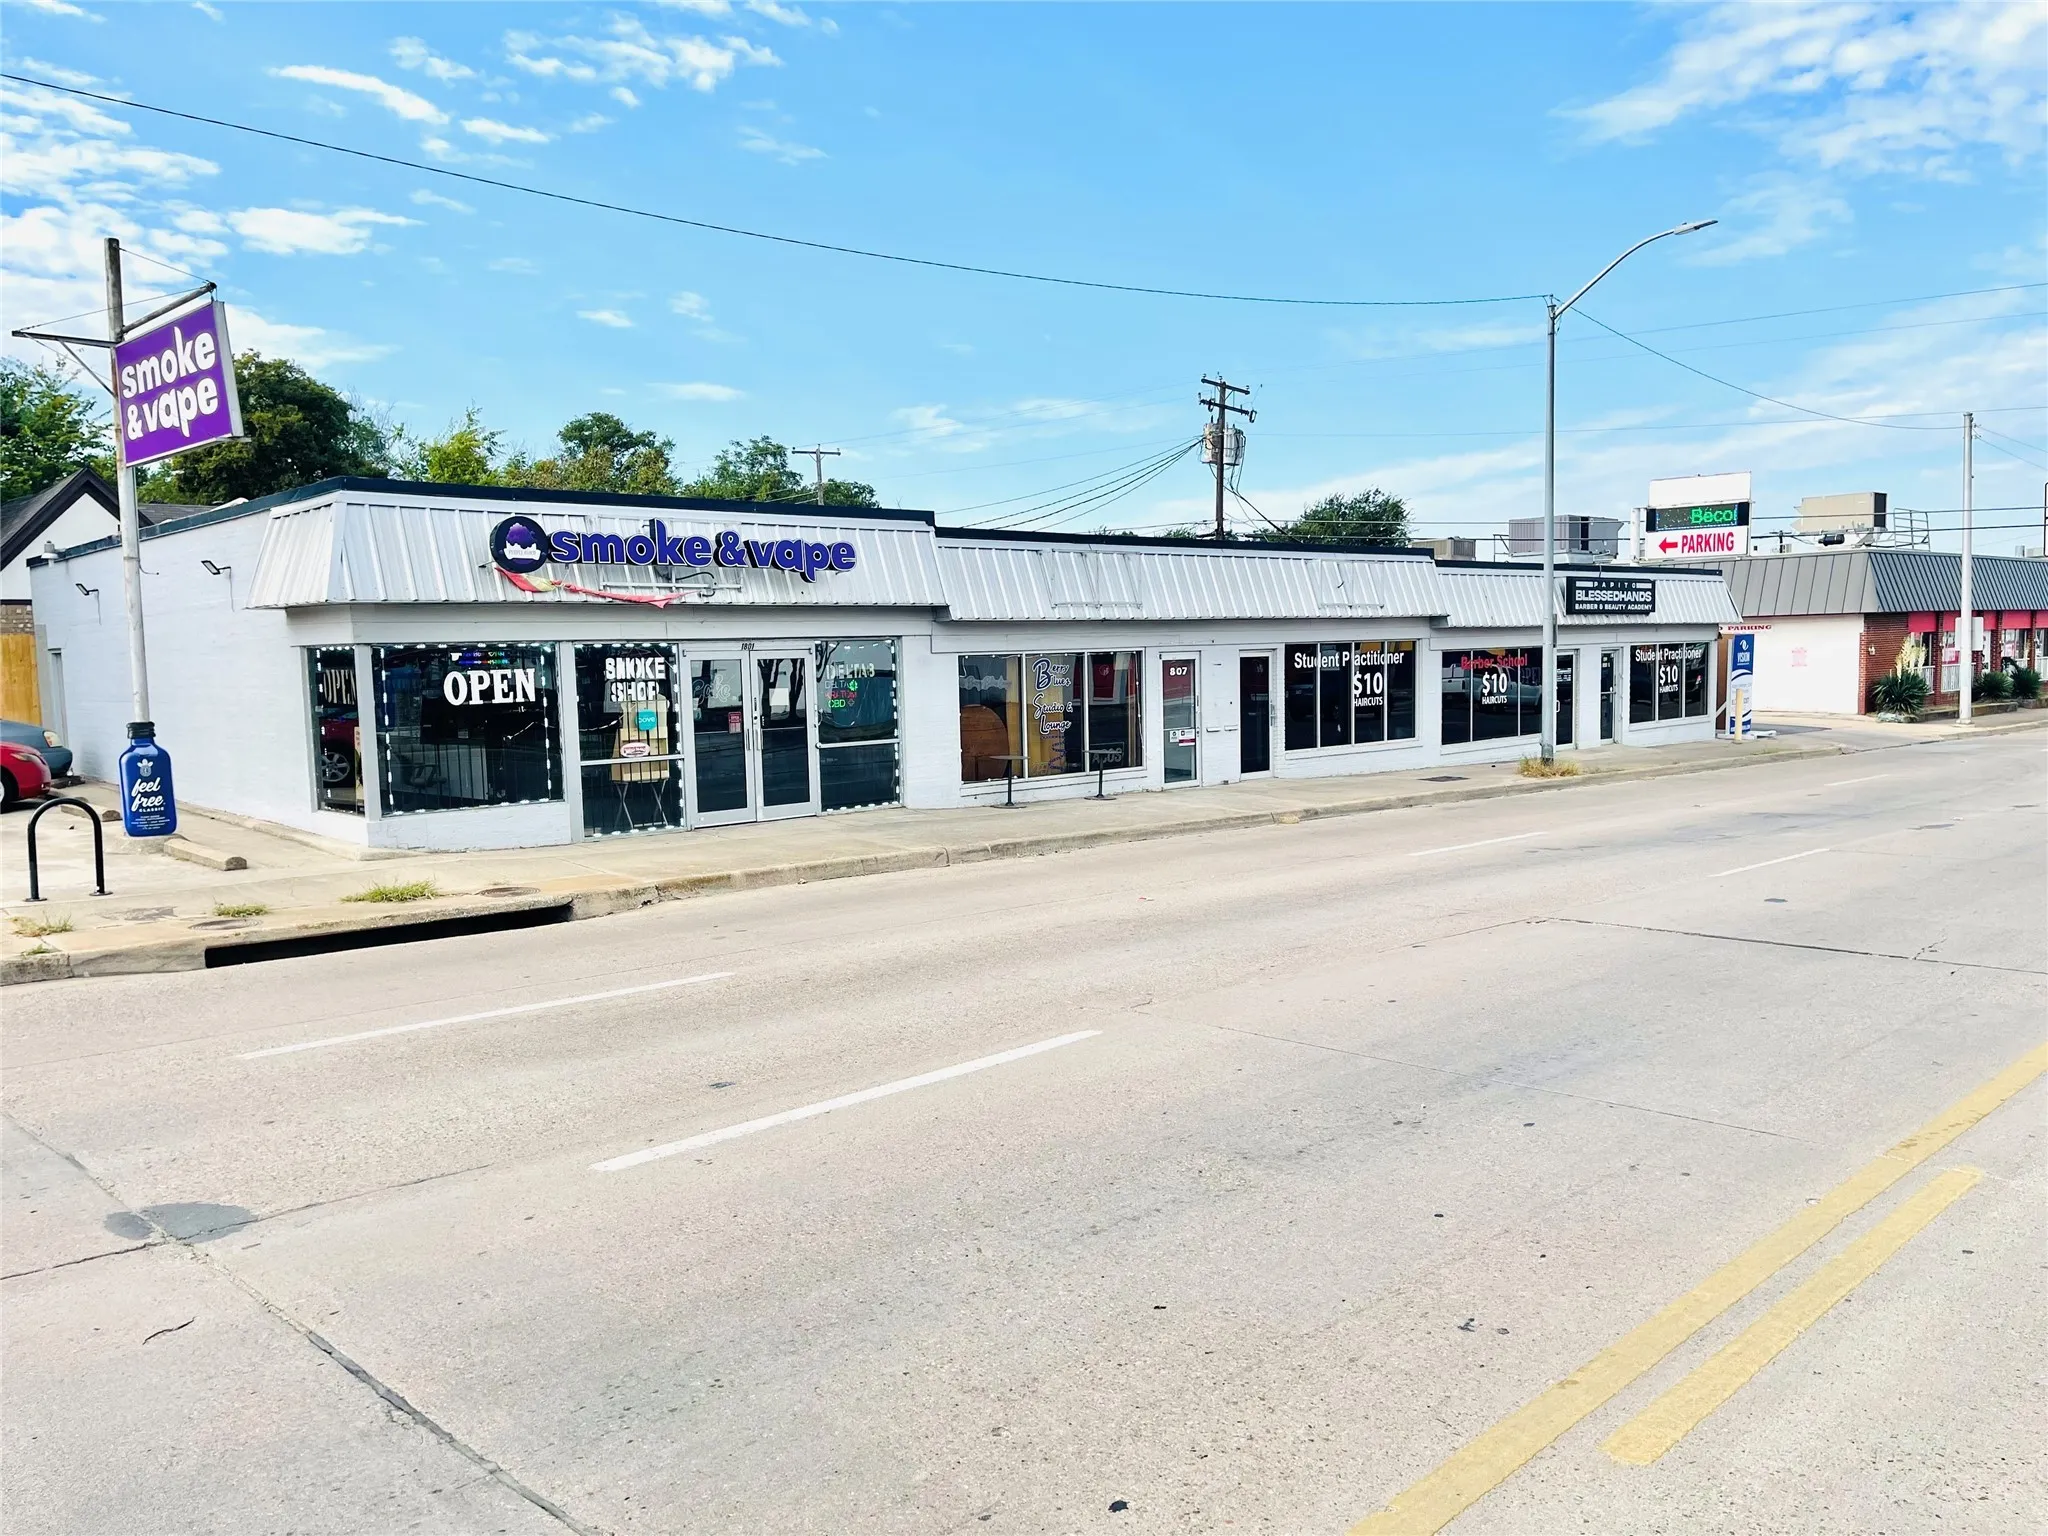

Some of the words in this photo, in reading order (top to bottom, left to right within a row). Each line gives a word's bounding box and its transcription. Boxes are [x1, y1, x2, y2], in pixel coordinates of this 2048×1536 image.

[121, 326, 216, 399] smoke
[1681, 532, 1735, 554] PARKING
[1575, 590, 1652, 602] BLESSEDHANDS
[605, 657, 667, 680] SMOKE
[1342, 650, 1404, 667] Pactitioner
[1461, 656, 1494, 670] Barber
[1497, 653, 1528, 668] School
[1169, 667, 1187, 676] 807
[1660, 665, 1678, 686] $10
[443, 668, 535, 706] OPEN
[611, 681, 660, 702] SHOP
[1353, 671, 1383, 698] $10
[1482, 672, 1507, 696] $10
[828, 699, 846, 708] CBD
[1033, 692, 1064, 719] Studio
[1354, 697, 1383, 707] HAIRCUTS
[1482, 696, 1507, 705] HAIRCUTS
[1040, 714, 1072, 734] Lounge
[131, 777, 160, 797] feel
[131, 794, 163, 812] free
